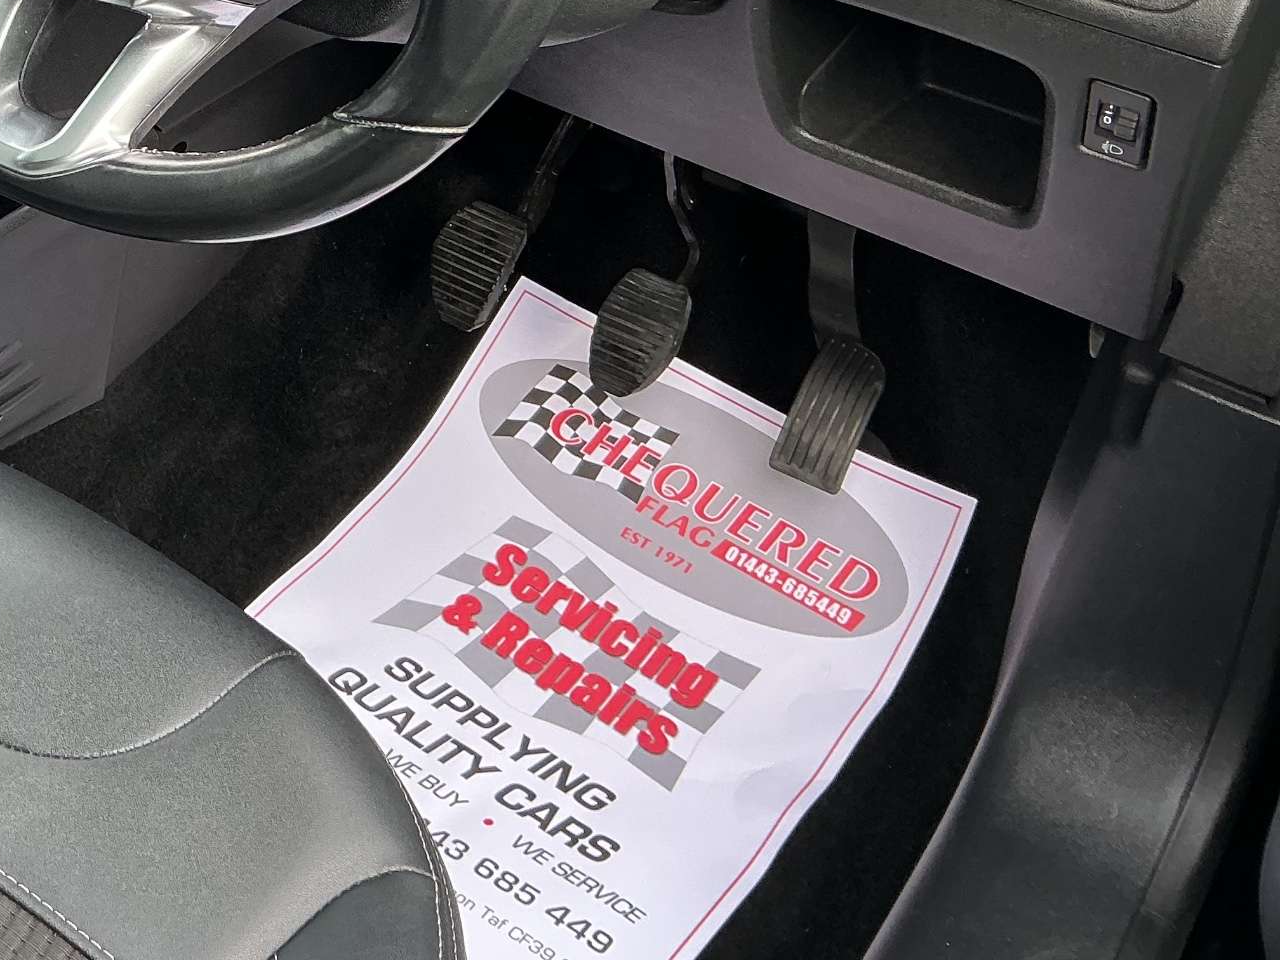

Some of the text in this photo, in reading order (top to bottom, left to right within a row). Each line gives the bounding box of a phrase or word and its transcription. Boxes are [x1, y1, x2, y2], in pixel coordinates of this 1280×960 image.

[550, 407, 881, 602] CHEQUERED
[620, 526, 695, 575] EST 1971
[635, 494, 717, 549] FLAG
[481, 541, 719, 710] Servicing
[723, 545, 853, 626] 01443-685449
[441, 593, 679, 756] & Repairs
[327, 666, 621, 864] QUALITY CARS
[383, 656, 617, 812] SUPPLYING
[417, 774, 470, 808] BUY
[473, 856, 541, 906] 685
[545, 905, 614, 954] 449
[511, 834, 648, 925] WE SERVICE
[481, 905, 510, 930] Taf
[507, 926, 557, 960] CF39
